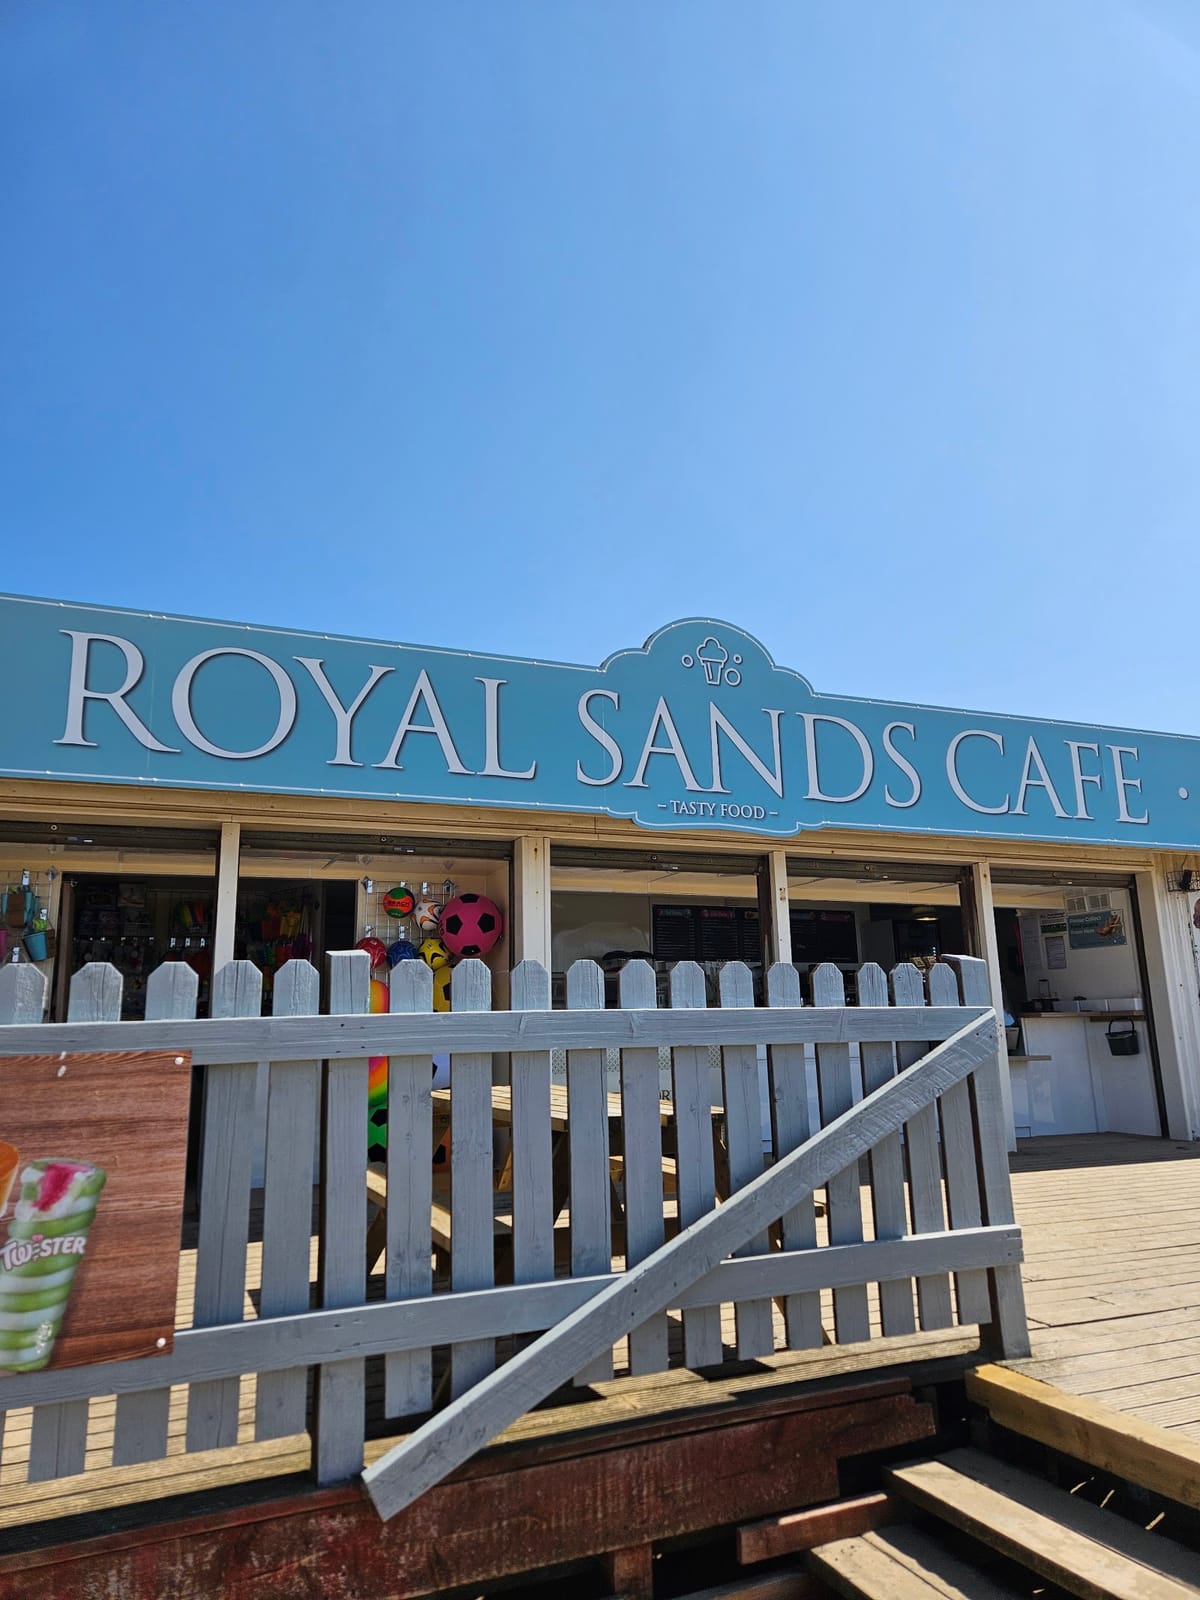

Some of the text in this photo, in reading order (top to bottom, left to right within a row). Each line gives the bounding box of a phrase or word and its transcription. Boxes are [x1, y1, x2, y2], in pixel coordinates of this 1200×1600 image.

[53, 629, 1150, 825] ROYAL SANDS CAFE
[670, 800, 765, 819] TASTY FOOD
